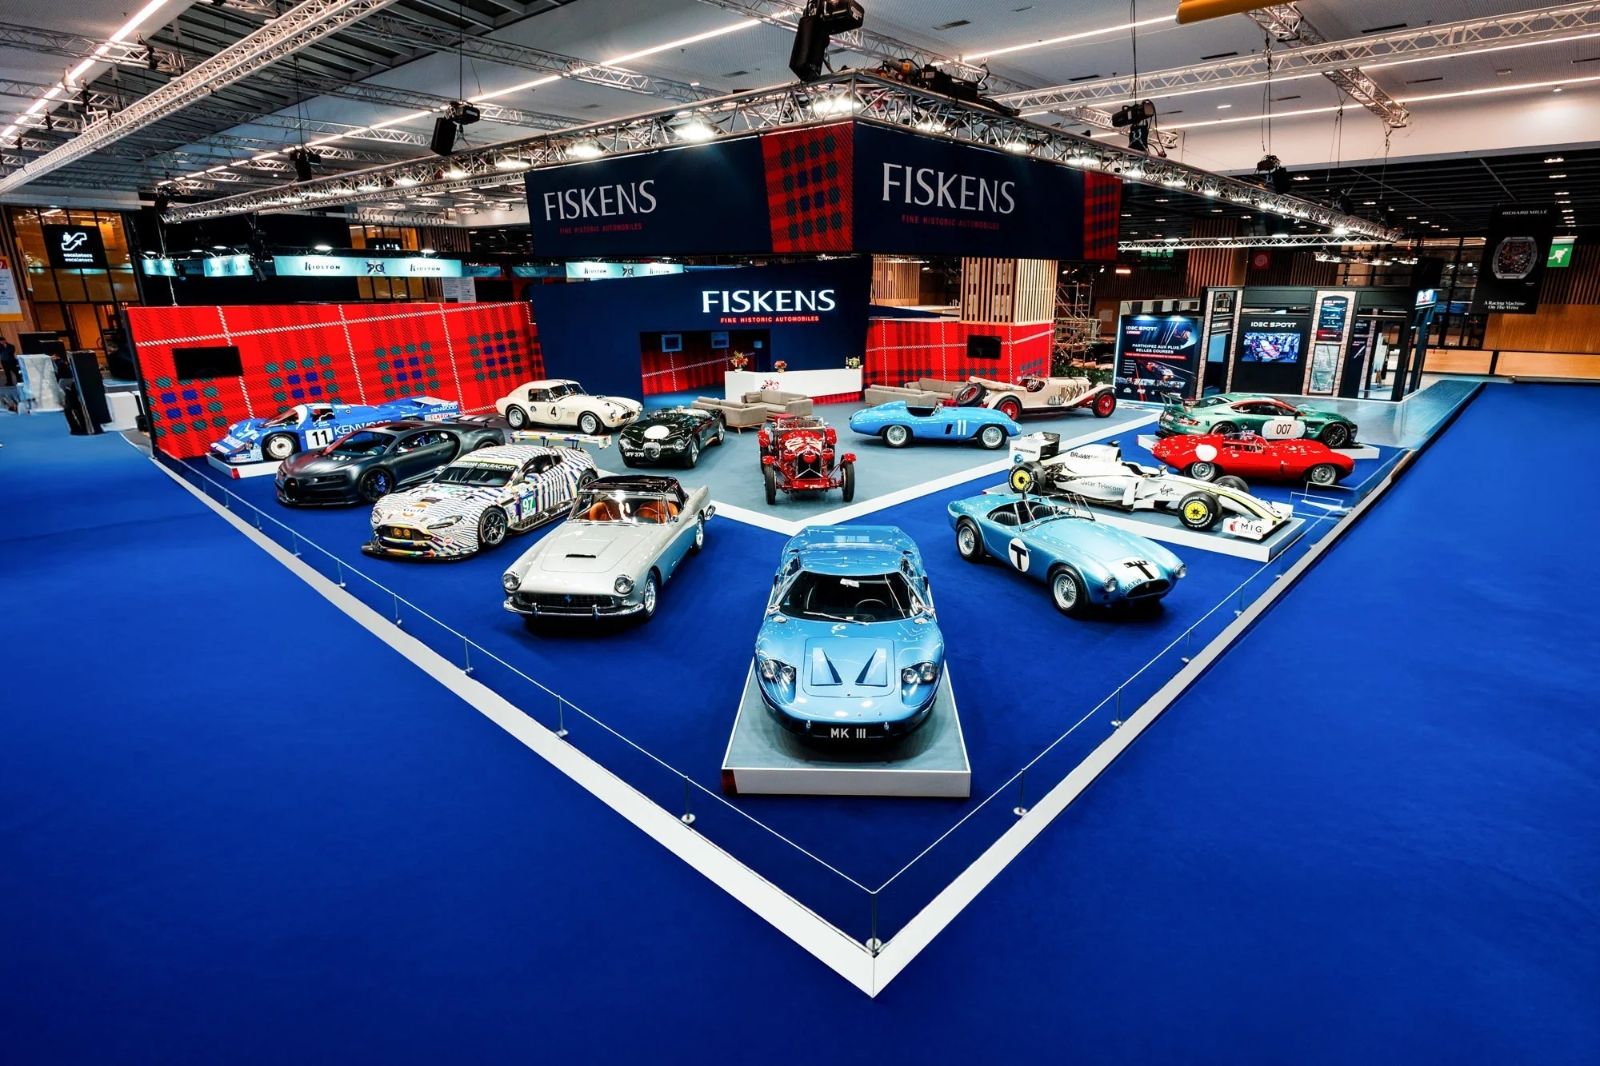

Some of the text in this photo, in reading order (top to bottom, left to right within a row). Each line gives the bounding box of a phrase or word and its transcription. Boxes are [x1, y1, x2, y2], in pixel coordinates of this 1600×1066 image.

[883, 162, 1015, 214] FISKENS
[543, 179, 657, 221] FISKENS
[902, 214, 919, 224] FINE
[923, 216, 956, 227] HISTORIC
[702, 289, 836, 313] FISKENS
[550, 406, 557, 418] 4
[957, 419, 967, 436] 11
[1276, 424, 1292, 434] 007
[312, 430, 329, 446] 11
[522, 498, 533, 511] 97
[1240, 522, 1262, 533] MIG
[1010, 543, 1027, 571] T
[830, 728, 867, 739] MK III
